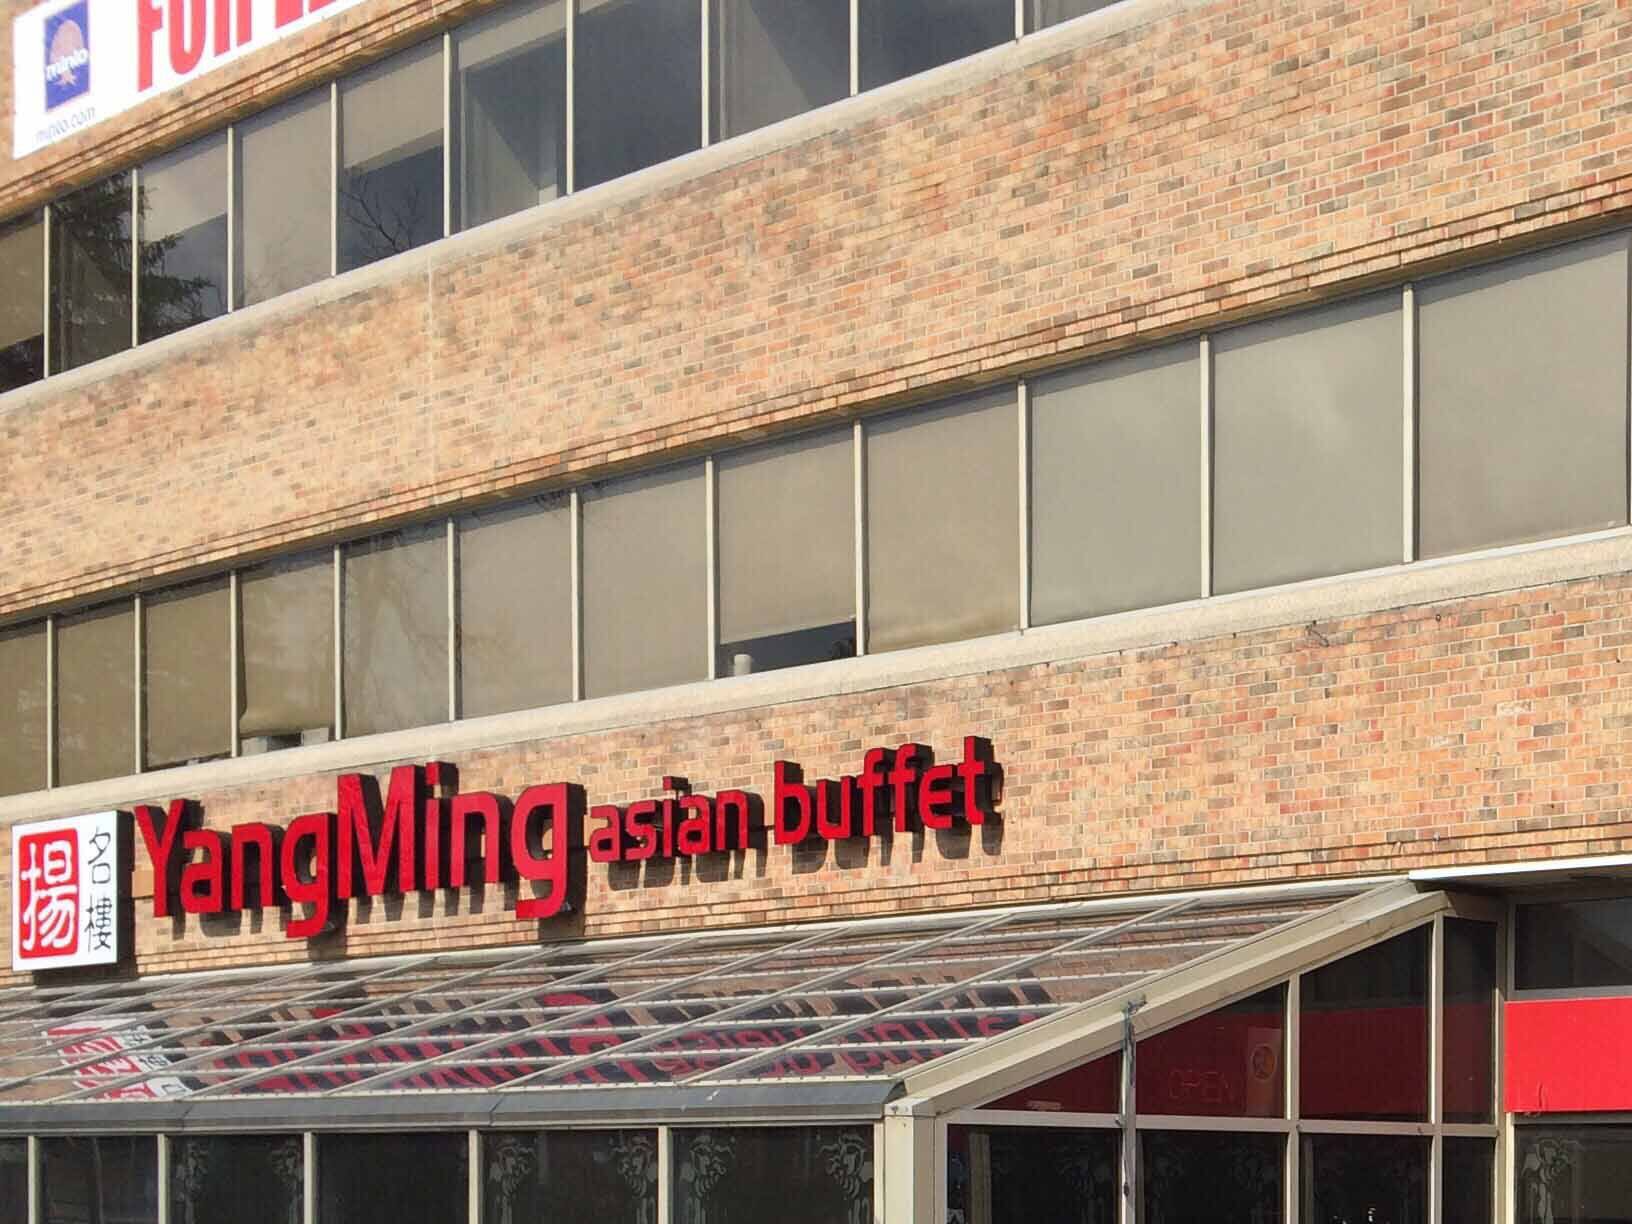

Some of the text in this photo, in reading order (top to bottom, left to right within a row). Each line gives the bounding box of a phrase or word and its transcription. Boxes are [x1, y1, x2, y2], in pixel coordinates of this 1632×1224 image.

[134, 735, 985, 938] YangMing asian buffet
